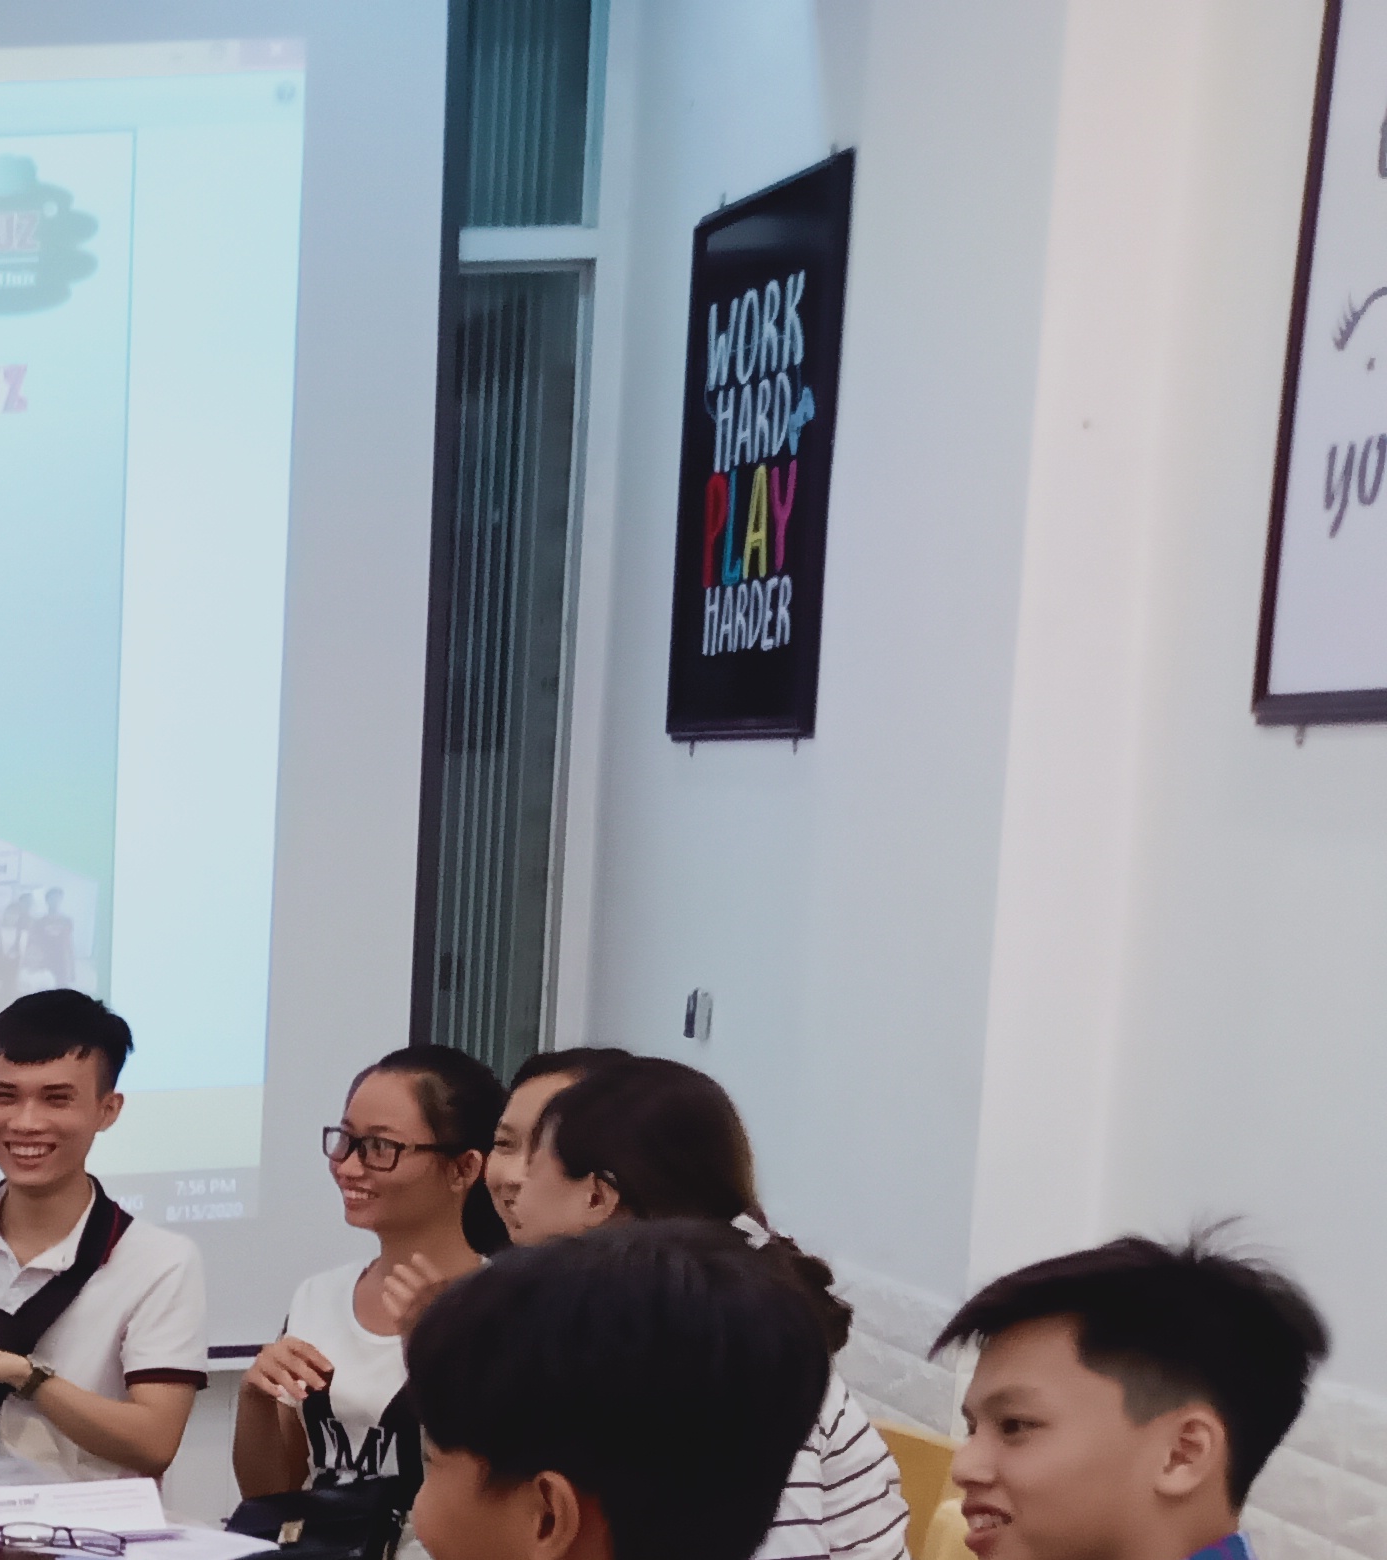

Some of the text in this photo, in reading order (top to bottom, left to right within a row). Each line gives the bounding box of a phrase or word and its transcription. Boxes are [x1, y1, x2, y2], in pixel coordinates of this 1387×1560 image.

[705, 269, 805, 391] WORK
[713, 372, 790, 473] HARD
[702, 459, 798, 588] PLAY
[702, 575, 793, 657] HARDER
[209, 1177, 238, 1195] PM
